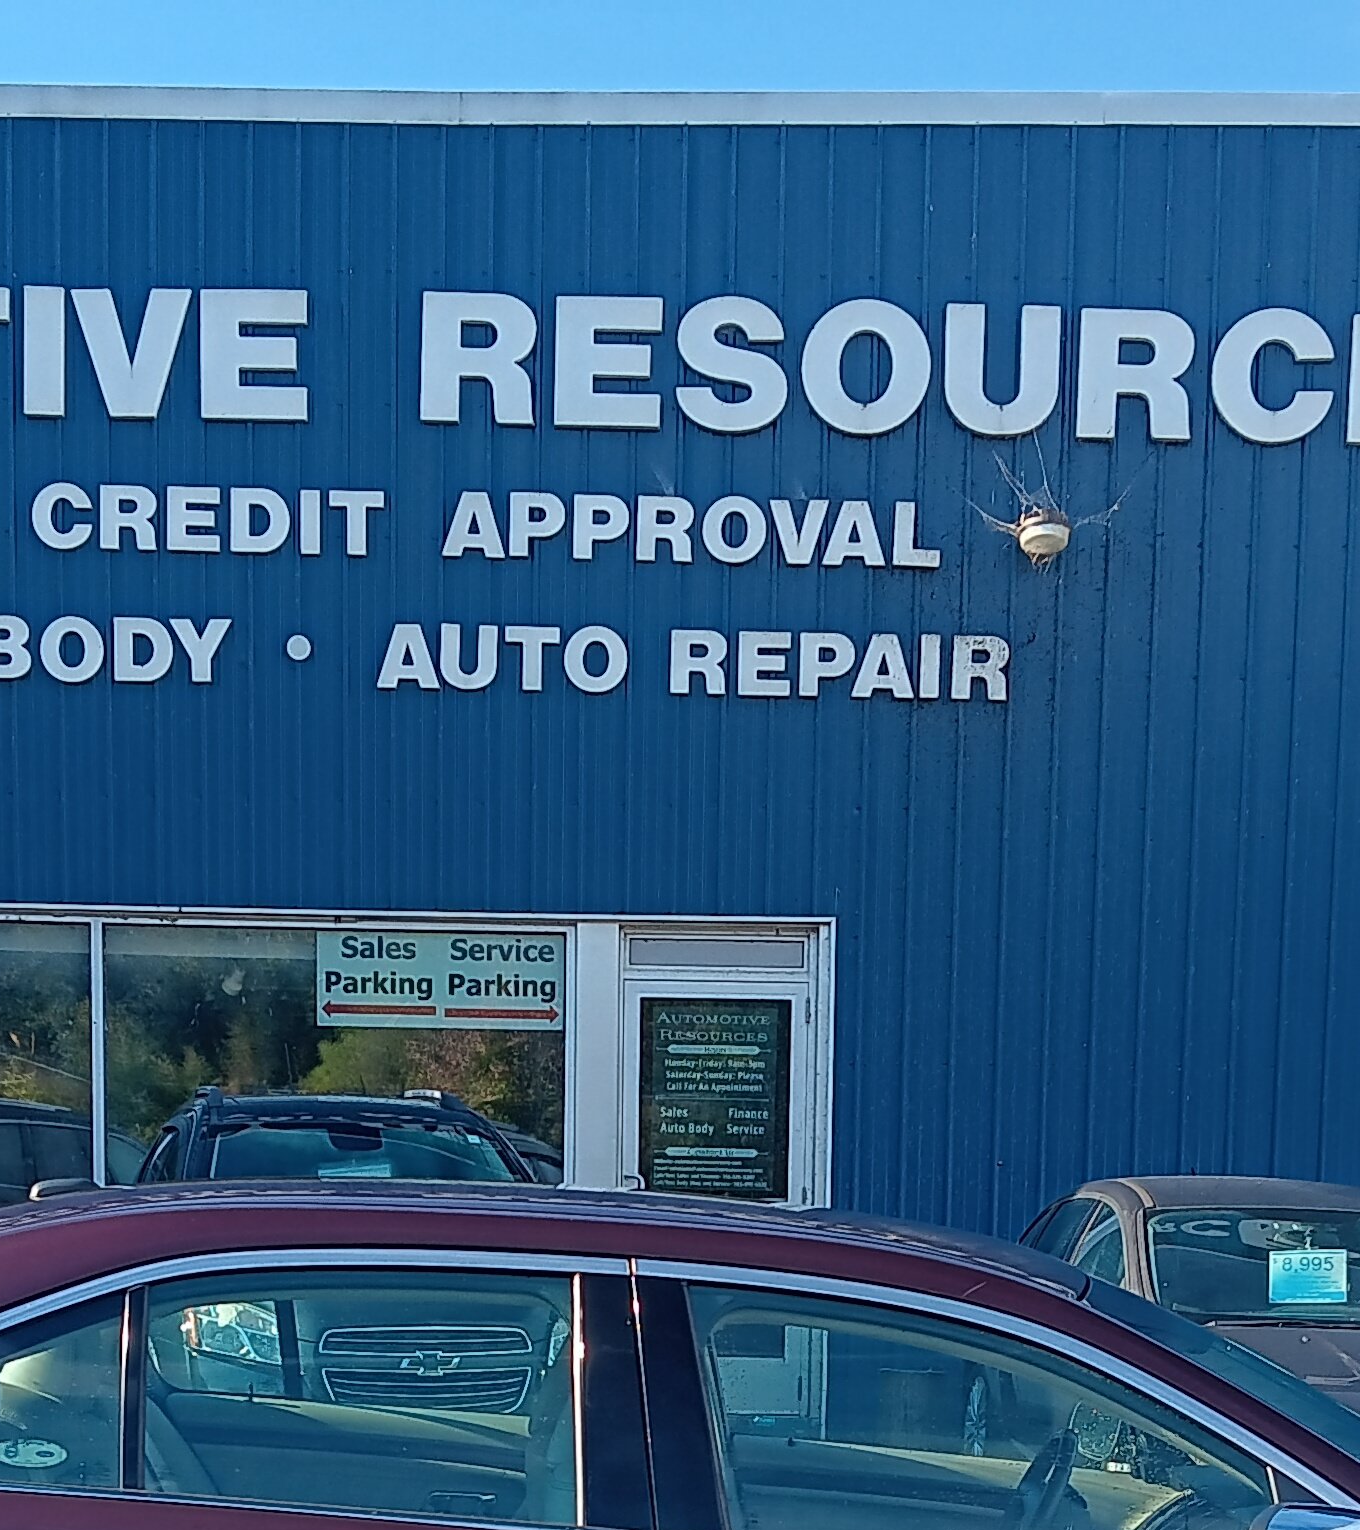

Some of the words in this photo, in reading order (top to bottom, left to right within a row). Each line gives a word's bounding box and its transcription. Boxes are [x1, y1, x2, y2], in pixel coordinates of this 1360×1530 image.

[31, 483, 384, 556] CREDIT
[442, 491, 941, 568] APPROVAL
[377, 622, 628, 693] AUTO
[669, 629, 1010, 701] REPAIR
[341, 936, 416, 960] Sales
[450, 939, 555, 962] Service
[325, 971, 433, 1001] Parking
[448, 974, 556, 1003] Parking
[656, 1012, 771, 1026] AUTOMOTIVE
[660, 1029, 768, 1042] RESOURCES
[660, 1106, 689, 1118] Sales
[728, 1107, 769, 1119] Finance
[659, 1121, 686, 1134] Auto
[688, 1122, 714, 1136] Body
[726, 1123, 765, 1135] Service
